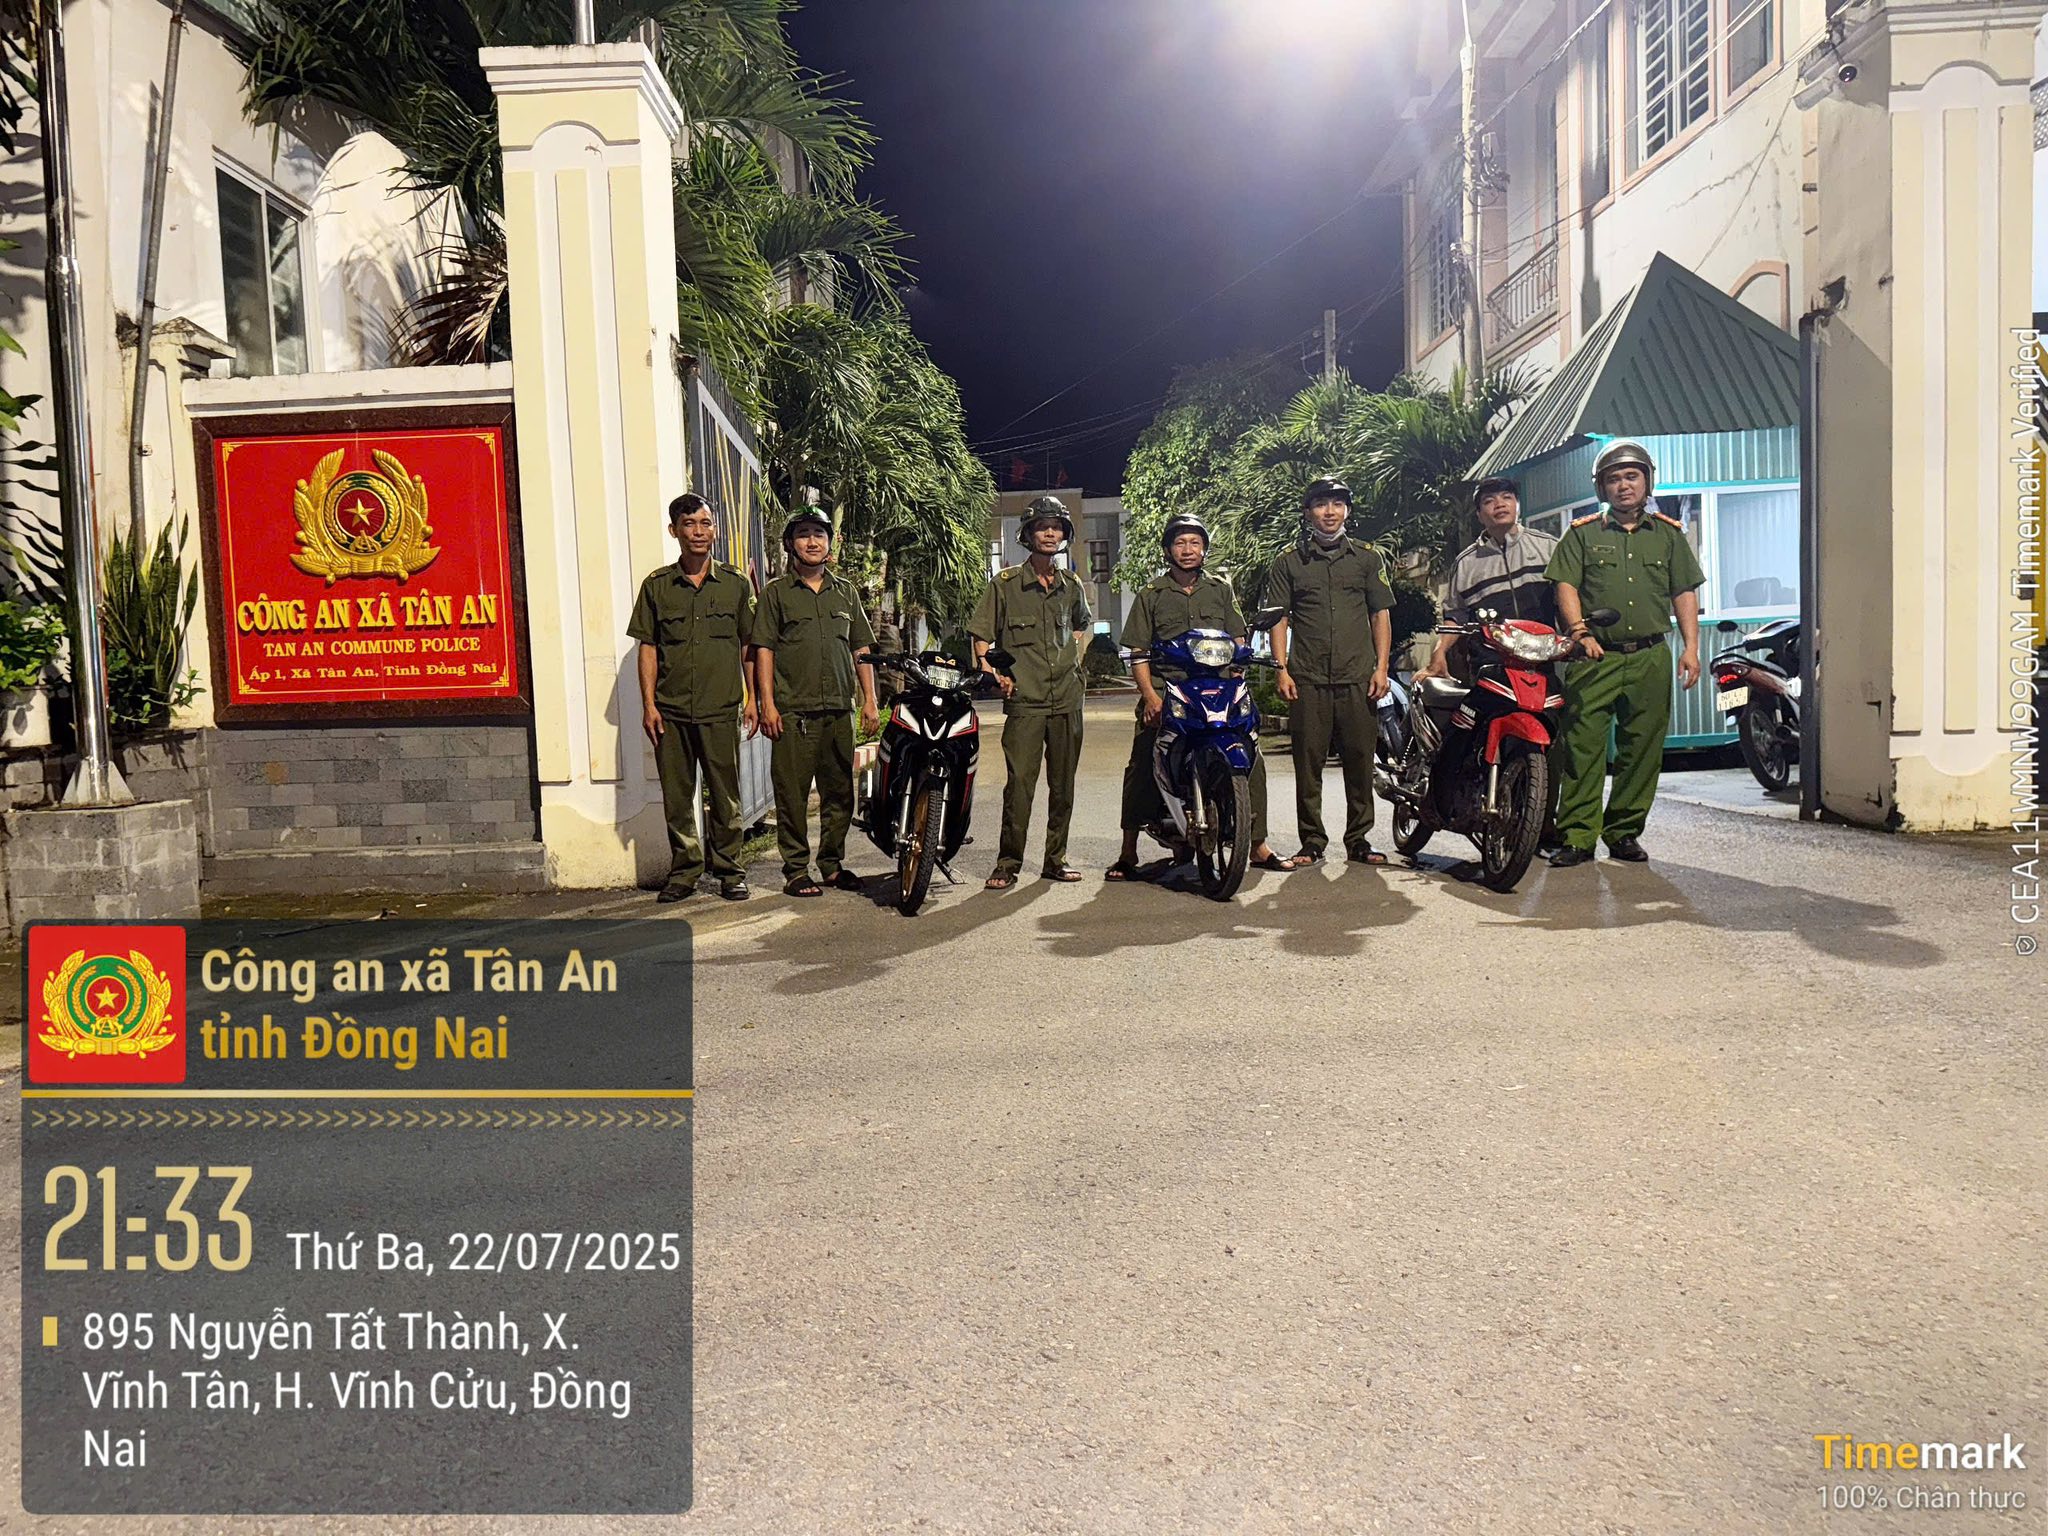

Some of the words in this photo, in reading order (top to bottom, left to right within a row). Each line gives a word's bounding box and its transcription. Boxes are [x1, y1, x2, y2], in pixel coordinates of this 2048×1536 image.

[237, 592, 308, 631] CÔNG
[314, 598, 351, 629] AN
[356, 591, 397, 627] XÃ
[400, 588, 452, 626] TÂN
[460, 594, 497, 625] AN
[263, 643, 297, 657] TAN
[301, 641, 325, 656] AN
[330, 638, 416, 656] COMMUNE
[421, 637, 481, 653] POLICE
[249, 665, 271, 682] Ấp
[275, 669, 287, 681] 1,
[290, 667, 312, 679] Xã
[316, 666, 347, 678] Tân
[351, 666, 380, 678] An,
[426, 661, 467, 677] Đồng
[471, 662, 498, 674] Nai
